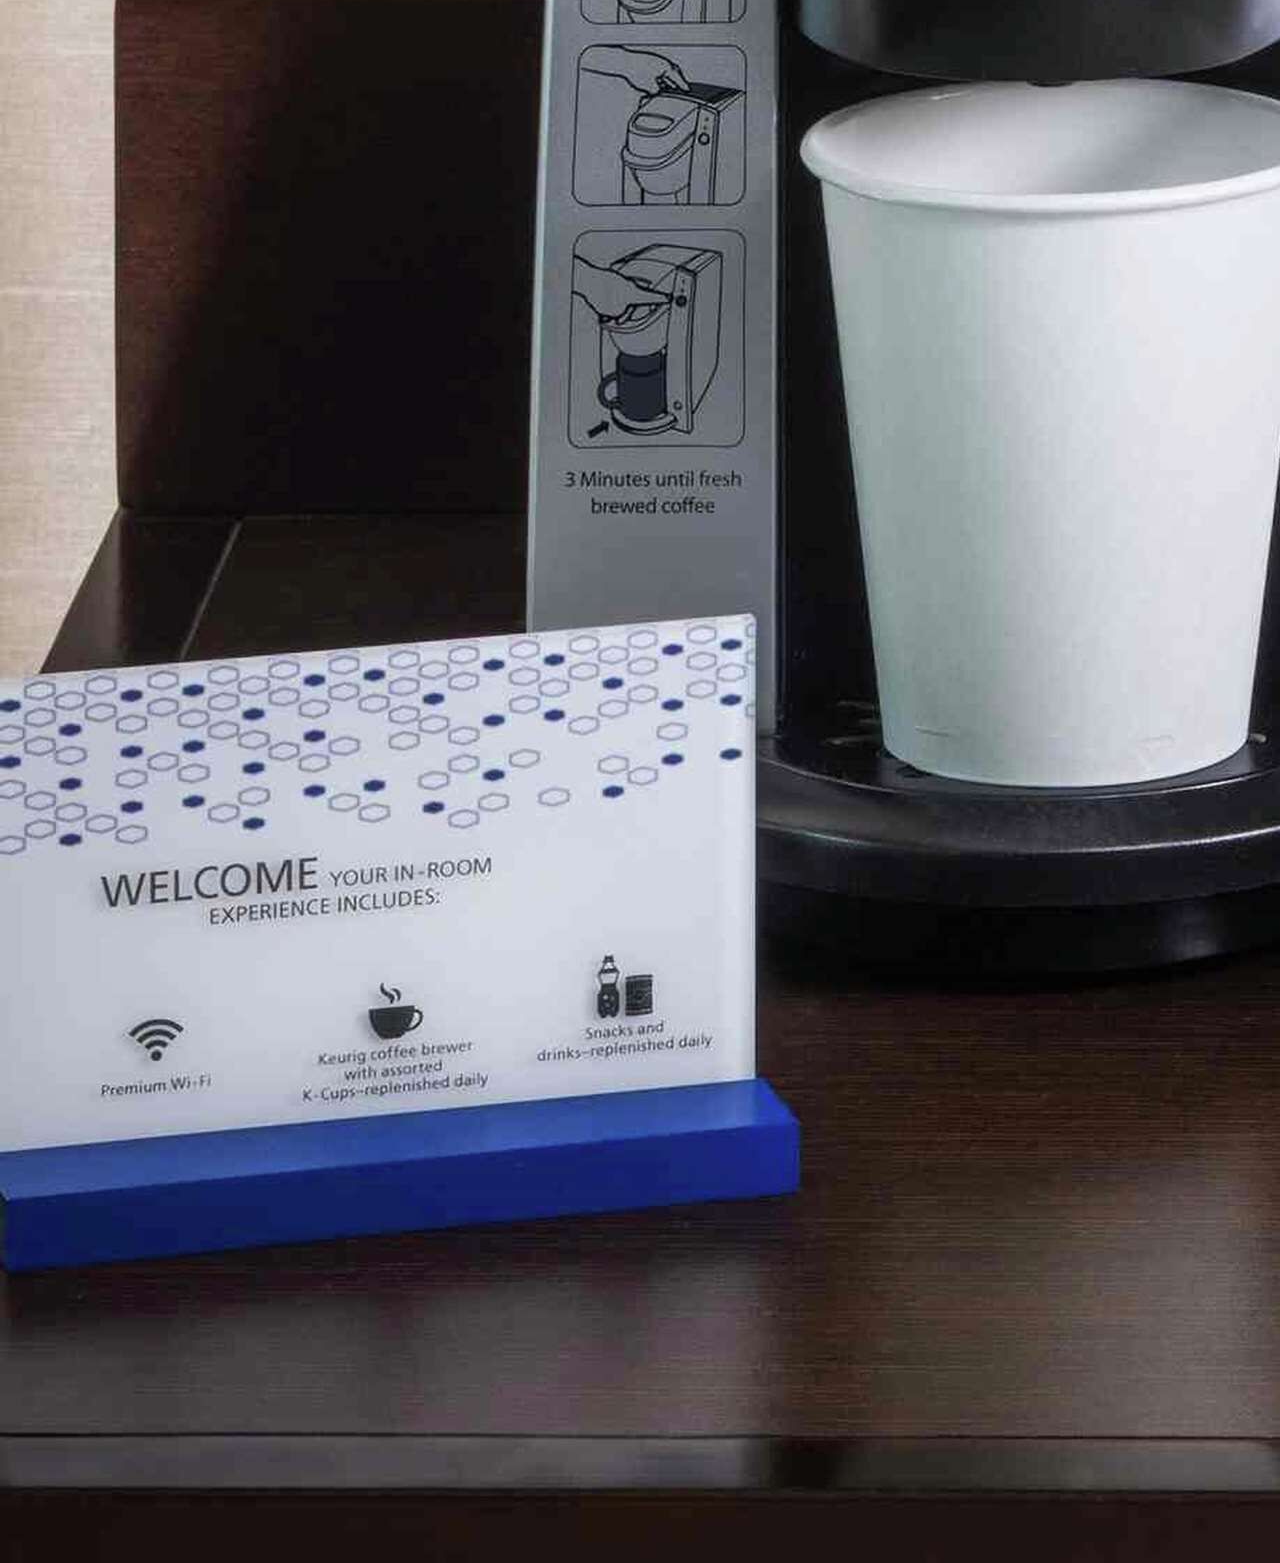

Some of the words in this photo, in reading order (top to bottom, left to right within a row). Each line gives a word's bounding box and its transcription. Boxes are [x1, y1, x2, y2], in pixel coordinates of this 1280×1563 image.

[565, 471, 576, 487] 3
[580, 470, 650, 488] Minutes
[656, 470, 694, 487] until
[699, 469, 742, 487] fresh
[591, 497, 657, 515] brewed
[661, 496, 716, 514] coffee
[101, 856, 319, 909] WELCOME
[328, 862, 388, 888] YOUR
[393, 856, 493, 883] IN-ROOM
[208, 896, 331, 925] EXPERIENCE
[336, 887, 442, 914] INCLUDES:
[585, 1023, 635, 1040] Snacks
[637, 1019, 667, 1035] and
[677, 1033, 714, 1049] daily
[316, 1048, 368, 1067] Keurig
[369, 1042, 419, 1062] coffee
[421, 1039, 474, 1057] brewer
[344, 1064, 377, 1082] with
[381, 1059, 443, 1079] assorted
[453, 1071, 490, 1091] daily
[99, 1079, 168, 1098] Premium
[170, 1074, 213, 1092] Wi-Fi
